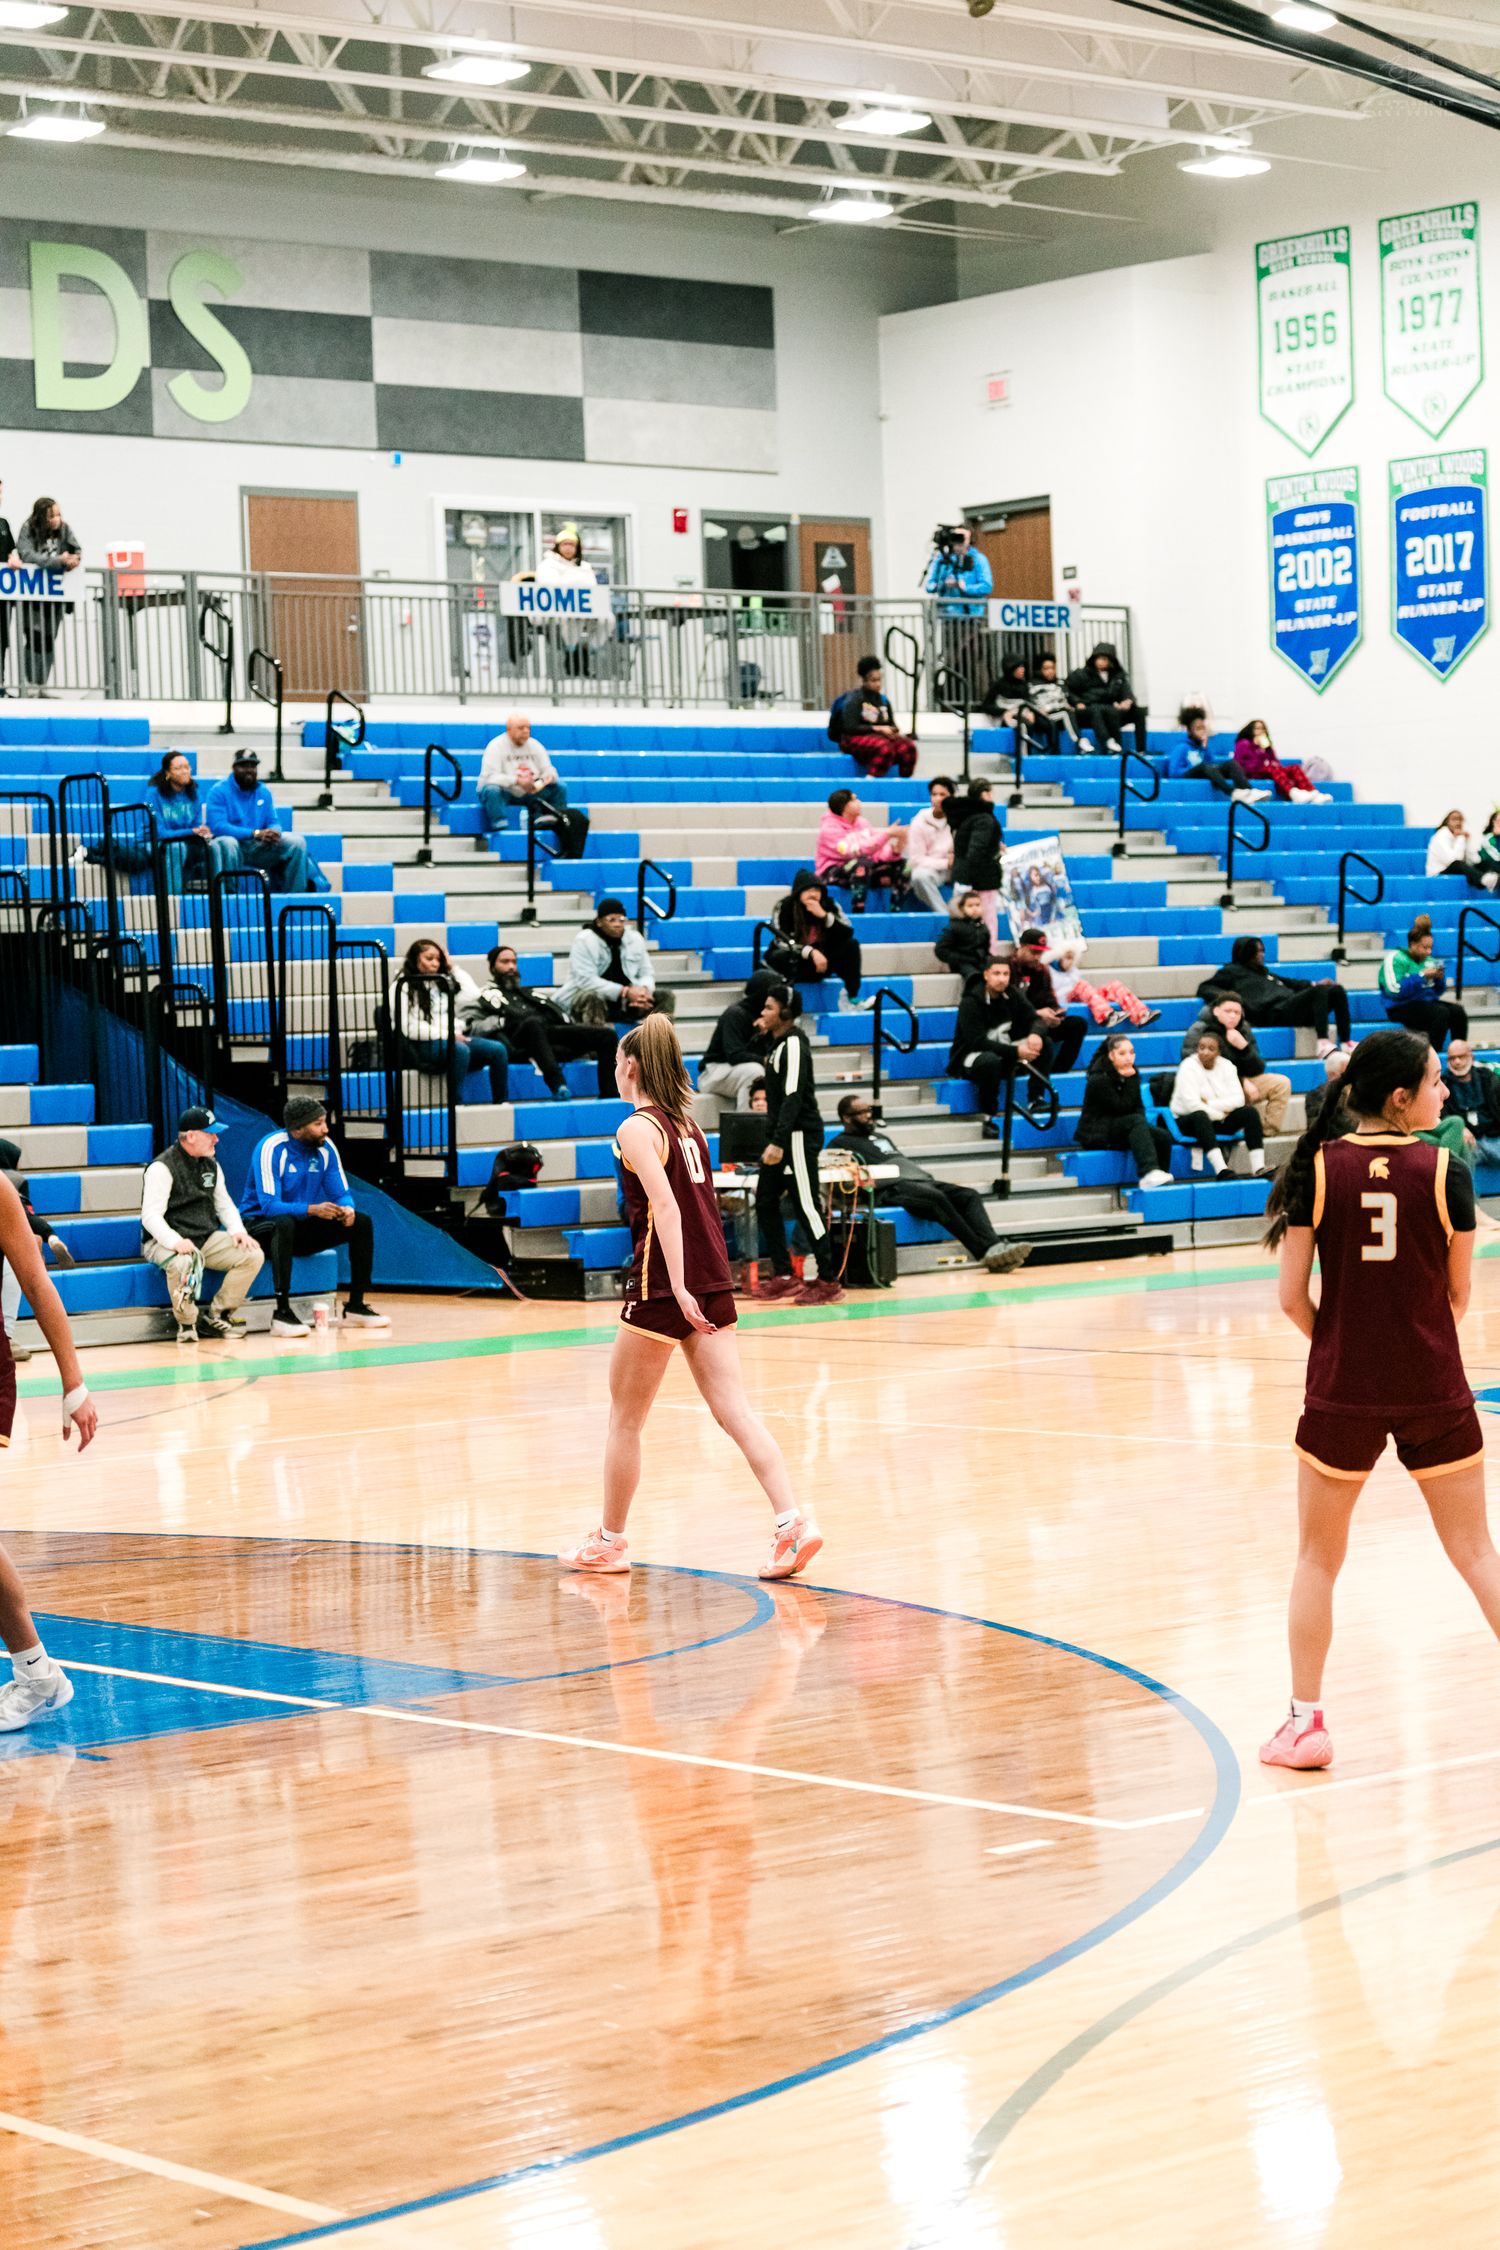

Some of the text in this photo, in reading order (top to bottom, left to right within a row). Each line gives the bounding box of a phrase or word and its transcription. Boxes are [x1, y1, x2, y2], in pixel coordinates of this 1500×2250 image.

[1389, 249, 1470, 271] BOYS CROSS
[1400, 267, 1458, 286] COUNTRY
[1268, 280, 1336, 300] BASEBALL
[1398, 288, 1463, 334] 1977
[29, 240, 252, 423] DS
[1274, 311, 1336, 353] 1956
[1411, 339, 1454, 354] STATE
[1286, 359, 1325, 374] STATE
[1267, 375, 1346, 396] CHAMPIONS
[1294, 509, 1332, 528] BOYS
[1400, 500, 1476, 523] FOOTBALL
[1274, 525, 1355, 548] BASKETBALL
[1405, 530, 1474, 577] 2017
[1278, 545, 1352, 592] 2002
[518, 586, 593, 613] HOME
[1417, 581, 1464, 599] STATE
[1294, 595, 1338, 613] STATE
[1397, 597, 1485, 620] RUNNER-UP
[1001, 604, 1070, 628] CHEER
[1276, 611, 1357, 633] RUNNER-UP
[1360, 1191, 1398, 1262] 3
